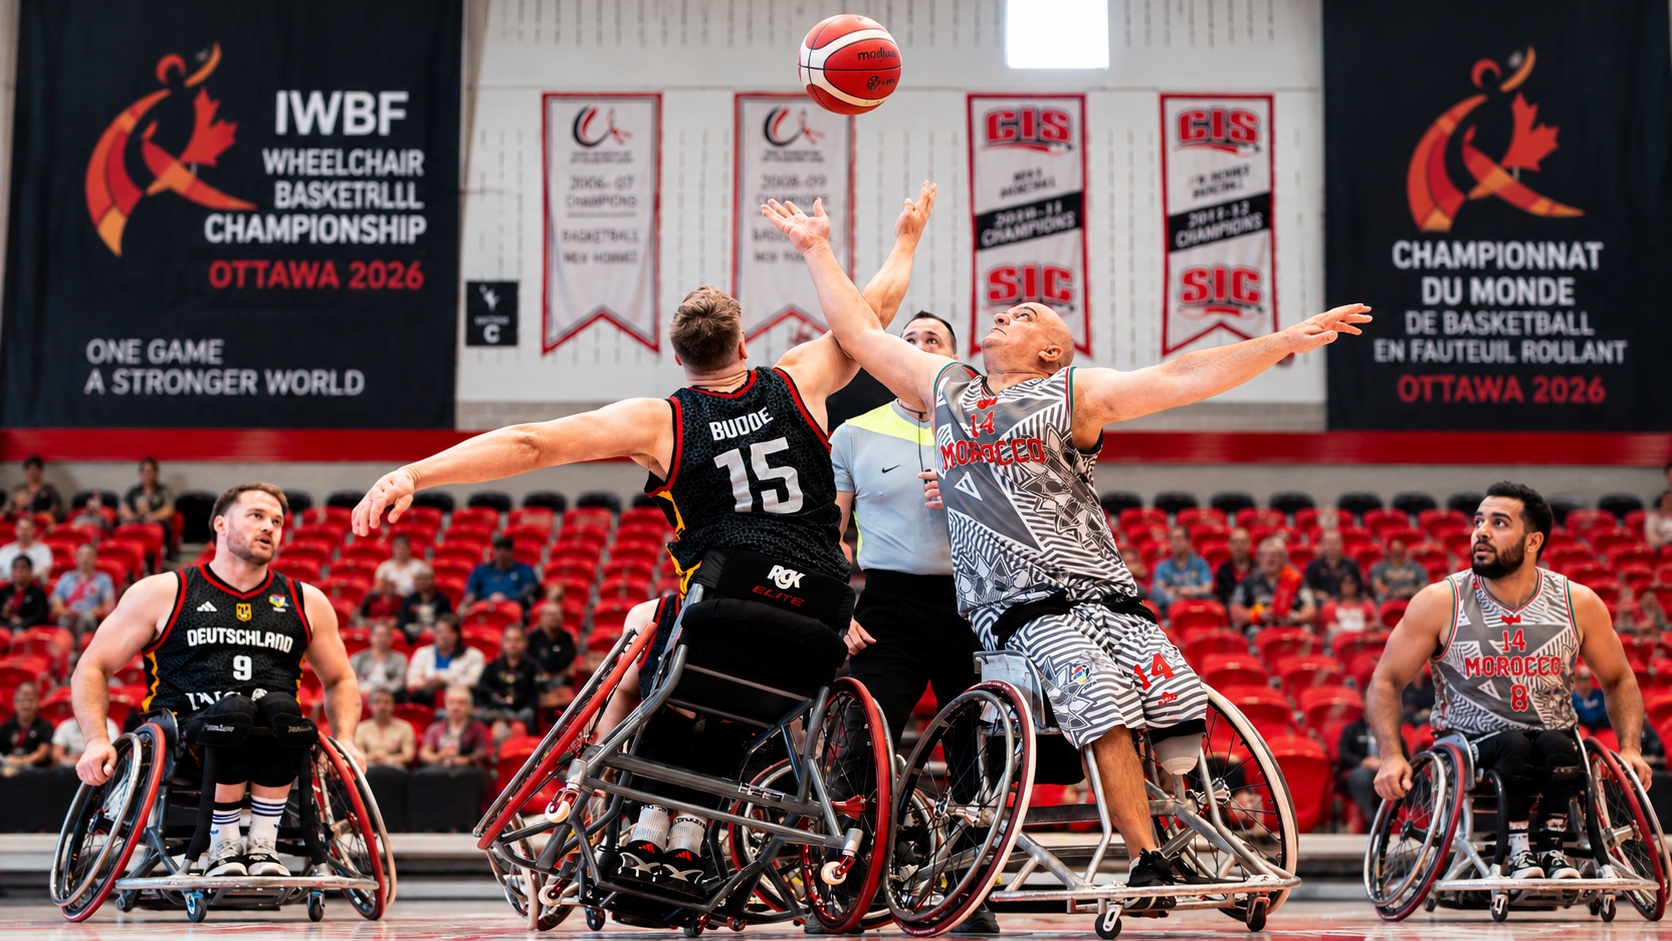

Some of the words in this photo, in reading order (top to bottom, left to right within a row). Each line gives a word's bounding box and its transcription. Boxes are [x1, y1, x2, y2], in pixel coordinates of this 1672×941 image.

[275, 90, 408, 136] IWBF
[984, 107, 1072, 144] CIS
[1177, 107, 1261, 145] CIS
[262, 149, 424, 176] WHEELCHAIR
[204, 215, 427, 244] CHAMPIONSHIP
[1392, 240, 1604, 270] CHAMPIONNAT
[208, 261, 339, 289] OTTAWA
[348, 261, 425, 290] 2026
[986, 265, 1074, 304] SIC
[1181, 266, 1262, 305] SIC
[1422, 277, 1462, 305] DU
[1470, 277, 1575, 306] MONDE
[483, 324, 501, 344] C
[1405, 311, 1437, 336] DE
[1443, 311, 1595, 336] BASKETBALL
[86, 339, 142, 364] ONE
[147, 339, 224, 364] GAME
[1374, 339, 1404, 362] EN
[1410, 339, 1517, 363] FAUTEUIL
[1523, 340, 1627, 364] ROULANT
[84, 370, 104, 394] A
[112, 369, 258, 395] STRONGER
[265, 370, 365, 396] WORLD
[1397, 375, 1523, 403] OTTAWA
[1532, 375, 1606, 403] 2026
[970, 411, 996, 438] 14
[939, 437, 1046, 471] MOROCCO
[713, 436, 804, 514] 15
[751, 585, 806, 607] ELITE
[187, 626, 293, 653] DEUTSCHLAND
[1502, 629, 1526, 653] 14
[232, 654, 253, 681] 9
[1133, 653, 1175, 691] 14
[1464, 656, 1562, 678] MOROCCO
[1510, 684, 1529, 712] 8
